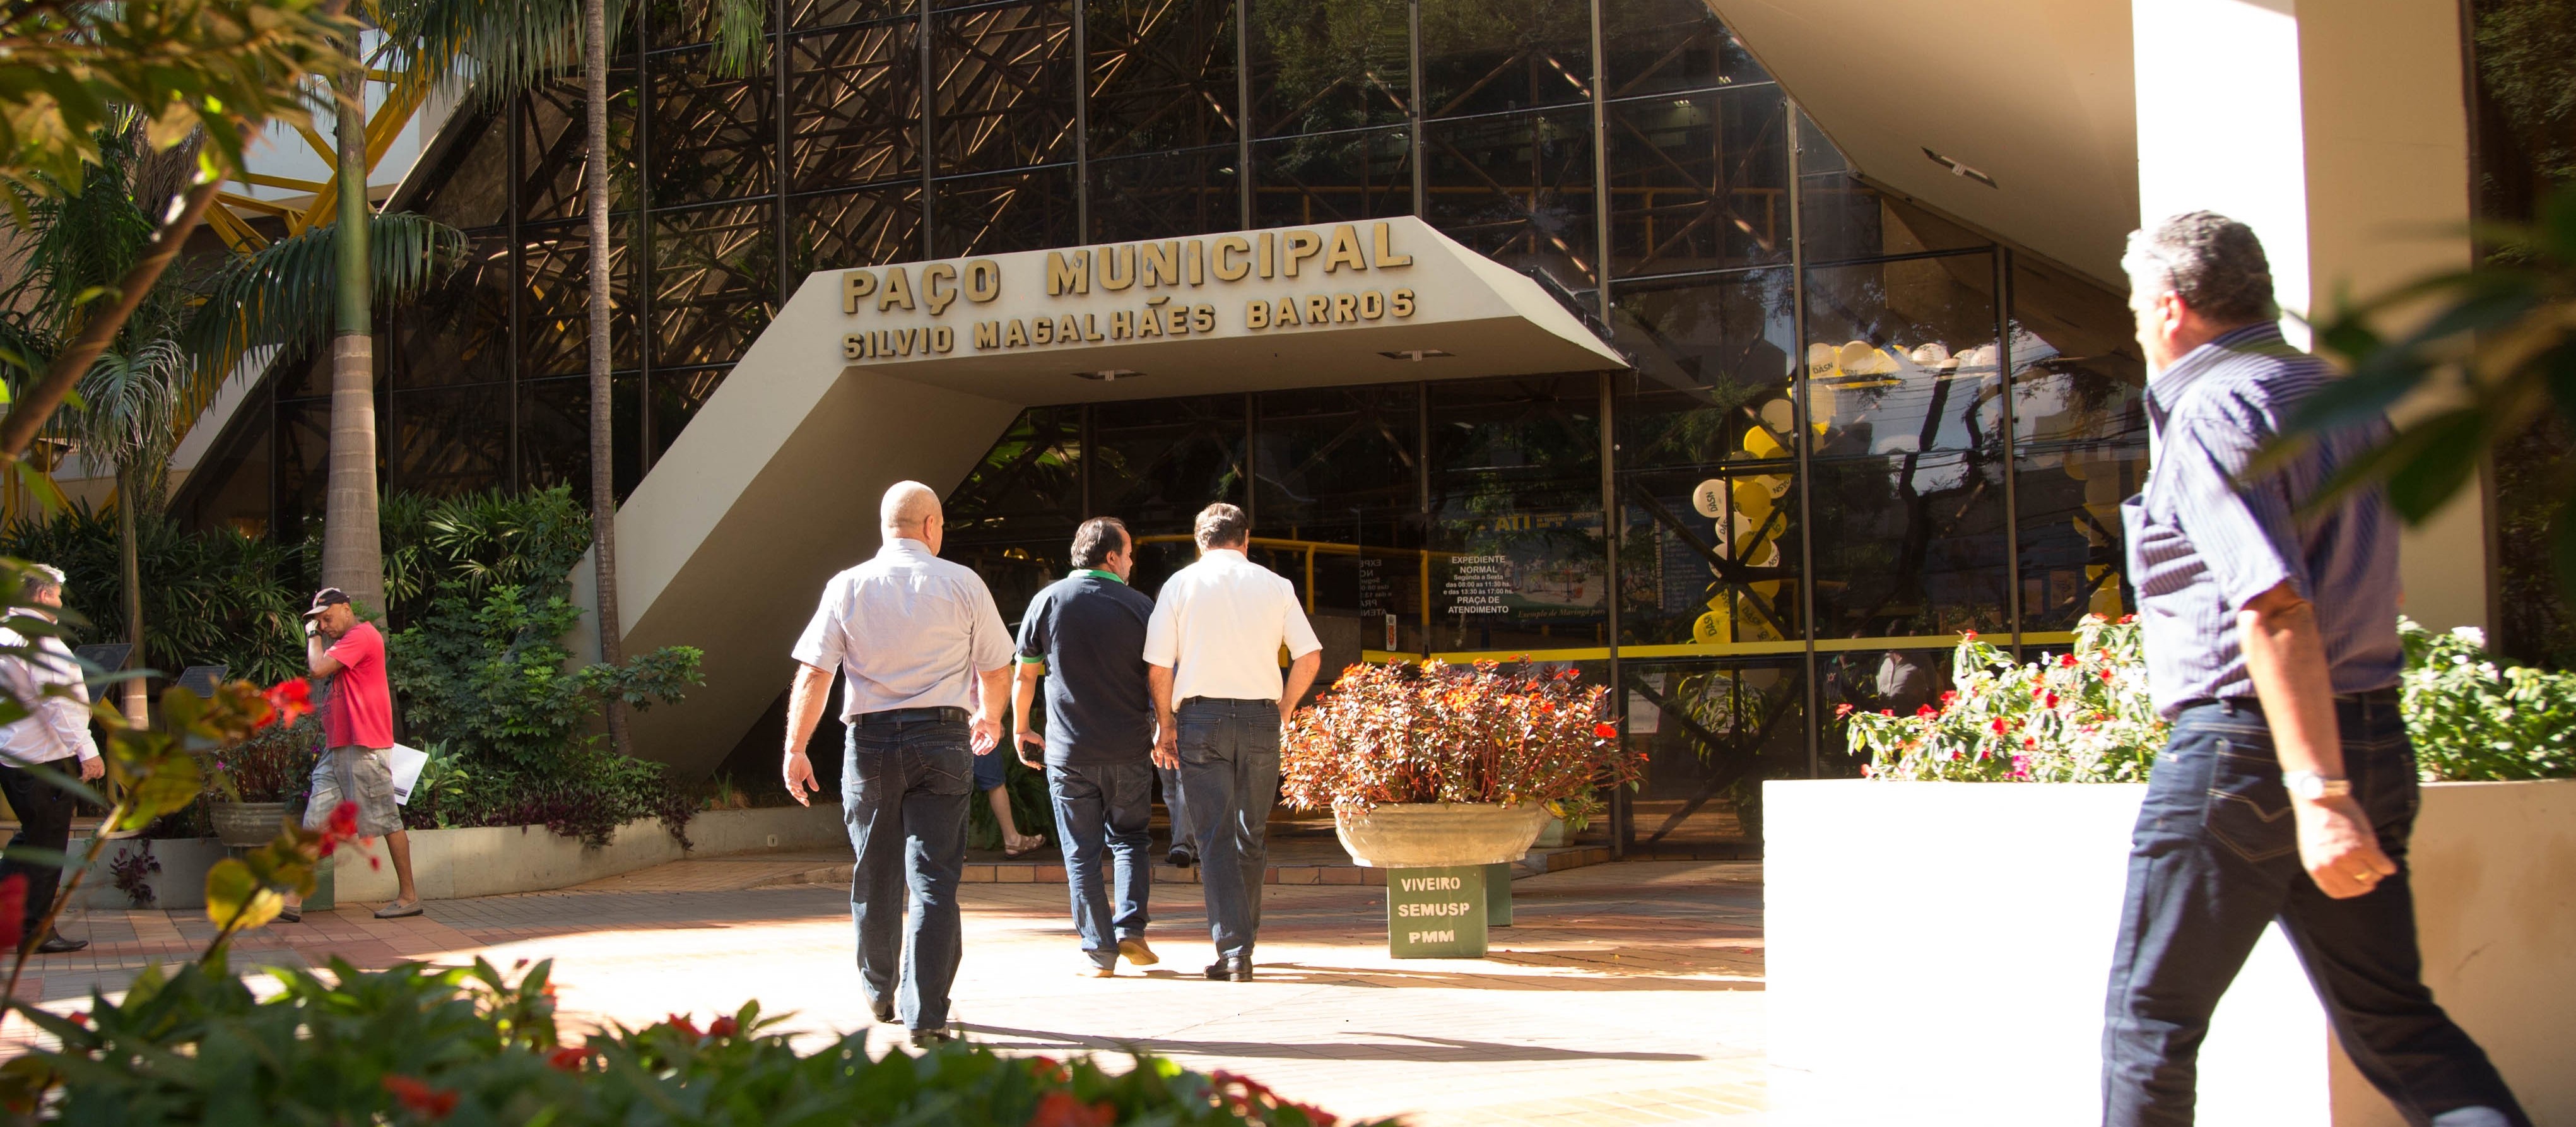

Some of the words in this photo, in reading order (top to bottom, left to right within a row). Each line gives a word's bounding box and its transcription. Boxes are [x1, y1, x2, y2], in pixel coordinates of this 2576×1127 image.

[842, 259, 1000, 316] PAÇO
[1047, 221, 1413, 297] MUNICIPAL
[842, 325, 954, 360] SILVIO
[1247, 288, 1416, 329] BARROS
[1813, 362, 1833, 374] DASN
[1706, 491, 1719, 512] DASN
[1494, 514, 1531, 531] ATI
[1452, 555, 1506, 564] EXPEDIENTE
[1460, 565, 1498, 574] NORMAL
[1457, 596, 1486, 605] PRAÇA
[1448, 606, 1509, 614] ATENDIMENTO
[1518, 608, 1547, 619] Exemplo
[1549, 608, 1557, 617] de
[1401, 877, 1461, 892] VIVEIRO
[1397, 902, 1470, 918] SEMUSP
[1408, 929, 1454, 944] PMM
